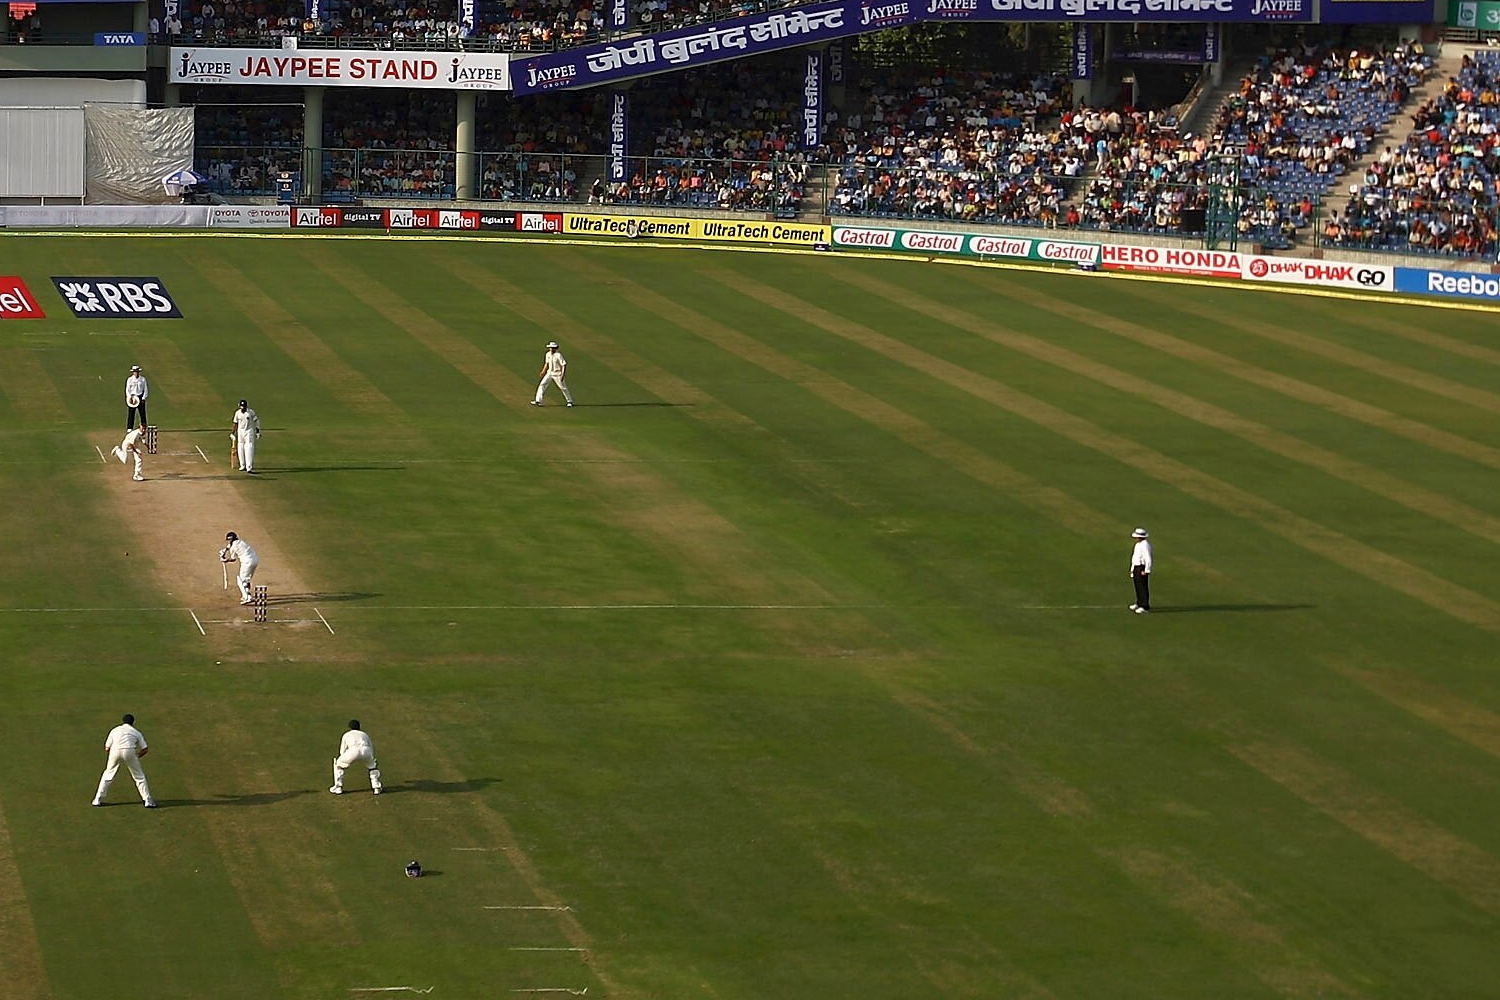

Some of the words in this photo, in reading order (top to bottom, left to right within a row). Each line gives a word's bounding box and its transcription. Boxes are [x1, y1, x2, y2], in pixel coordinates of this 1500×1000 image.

[861, 2, 910, 25] JAYPEE
[104, 34, 135, 44] TATA
[178, 56, 231, 78] JAYPEE
[239, 56, 342, 78] JAYPEE
[349, 58, 438, 80] STAND
[448, 61, 502, 84] JAYPEE
[527, 64, 576, 88] JAYPEE
[299, 211, 336, 226] Airtel
[344, 214, 366, 222] digital
[392, 212, 430, 228] Airtel
[441, 212, 476, 228] Airtel
[524, 215, 558, 231] Airtel
[638, 220, 690, 235] Cement
[704, 222, 768, 238] UltraTech
[772, 227, 824, 242] Cement
[840, 229, 890, 246] Castrol
[908, 234, 958, 250] Castrol
[976, 238, 1026, 255] Castrol
[1044, 244, 1093, 261] Castrol
[1102, 246, 1159, 264] HERO
[1166, 250, 1240, 270] HONDA
[1270, 262, 1302, 274] DHAK
[1304, 264, 1354, 282] DHAK
[1356, 268, 1386, 286] GO
[95, 283, 172, 313] RBS
